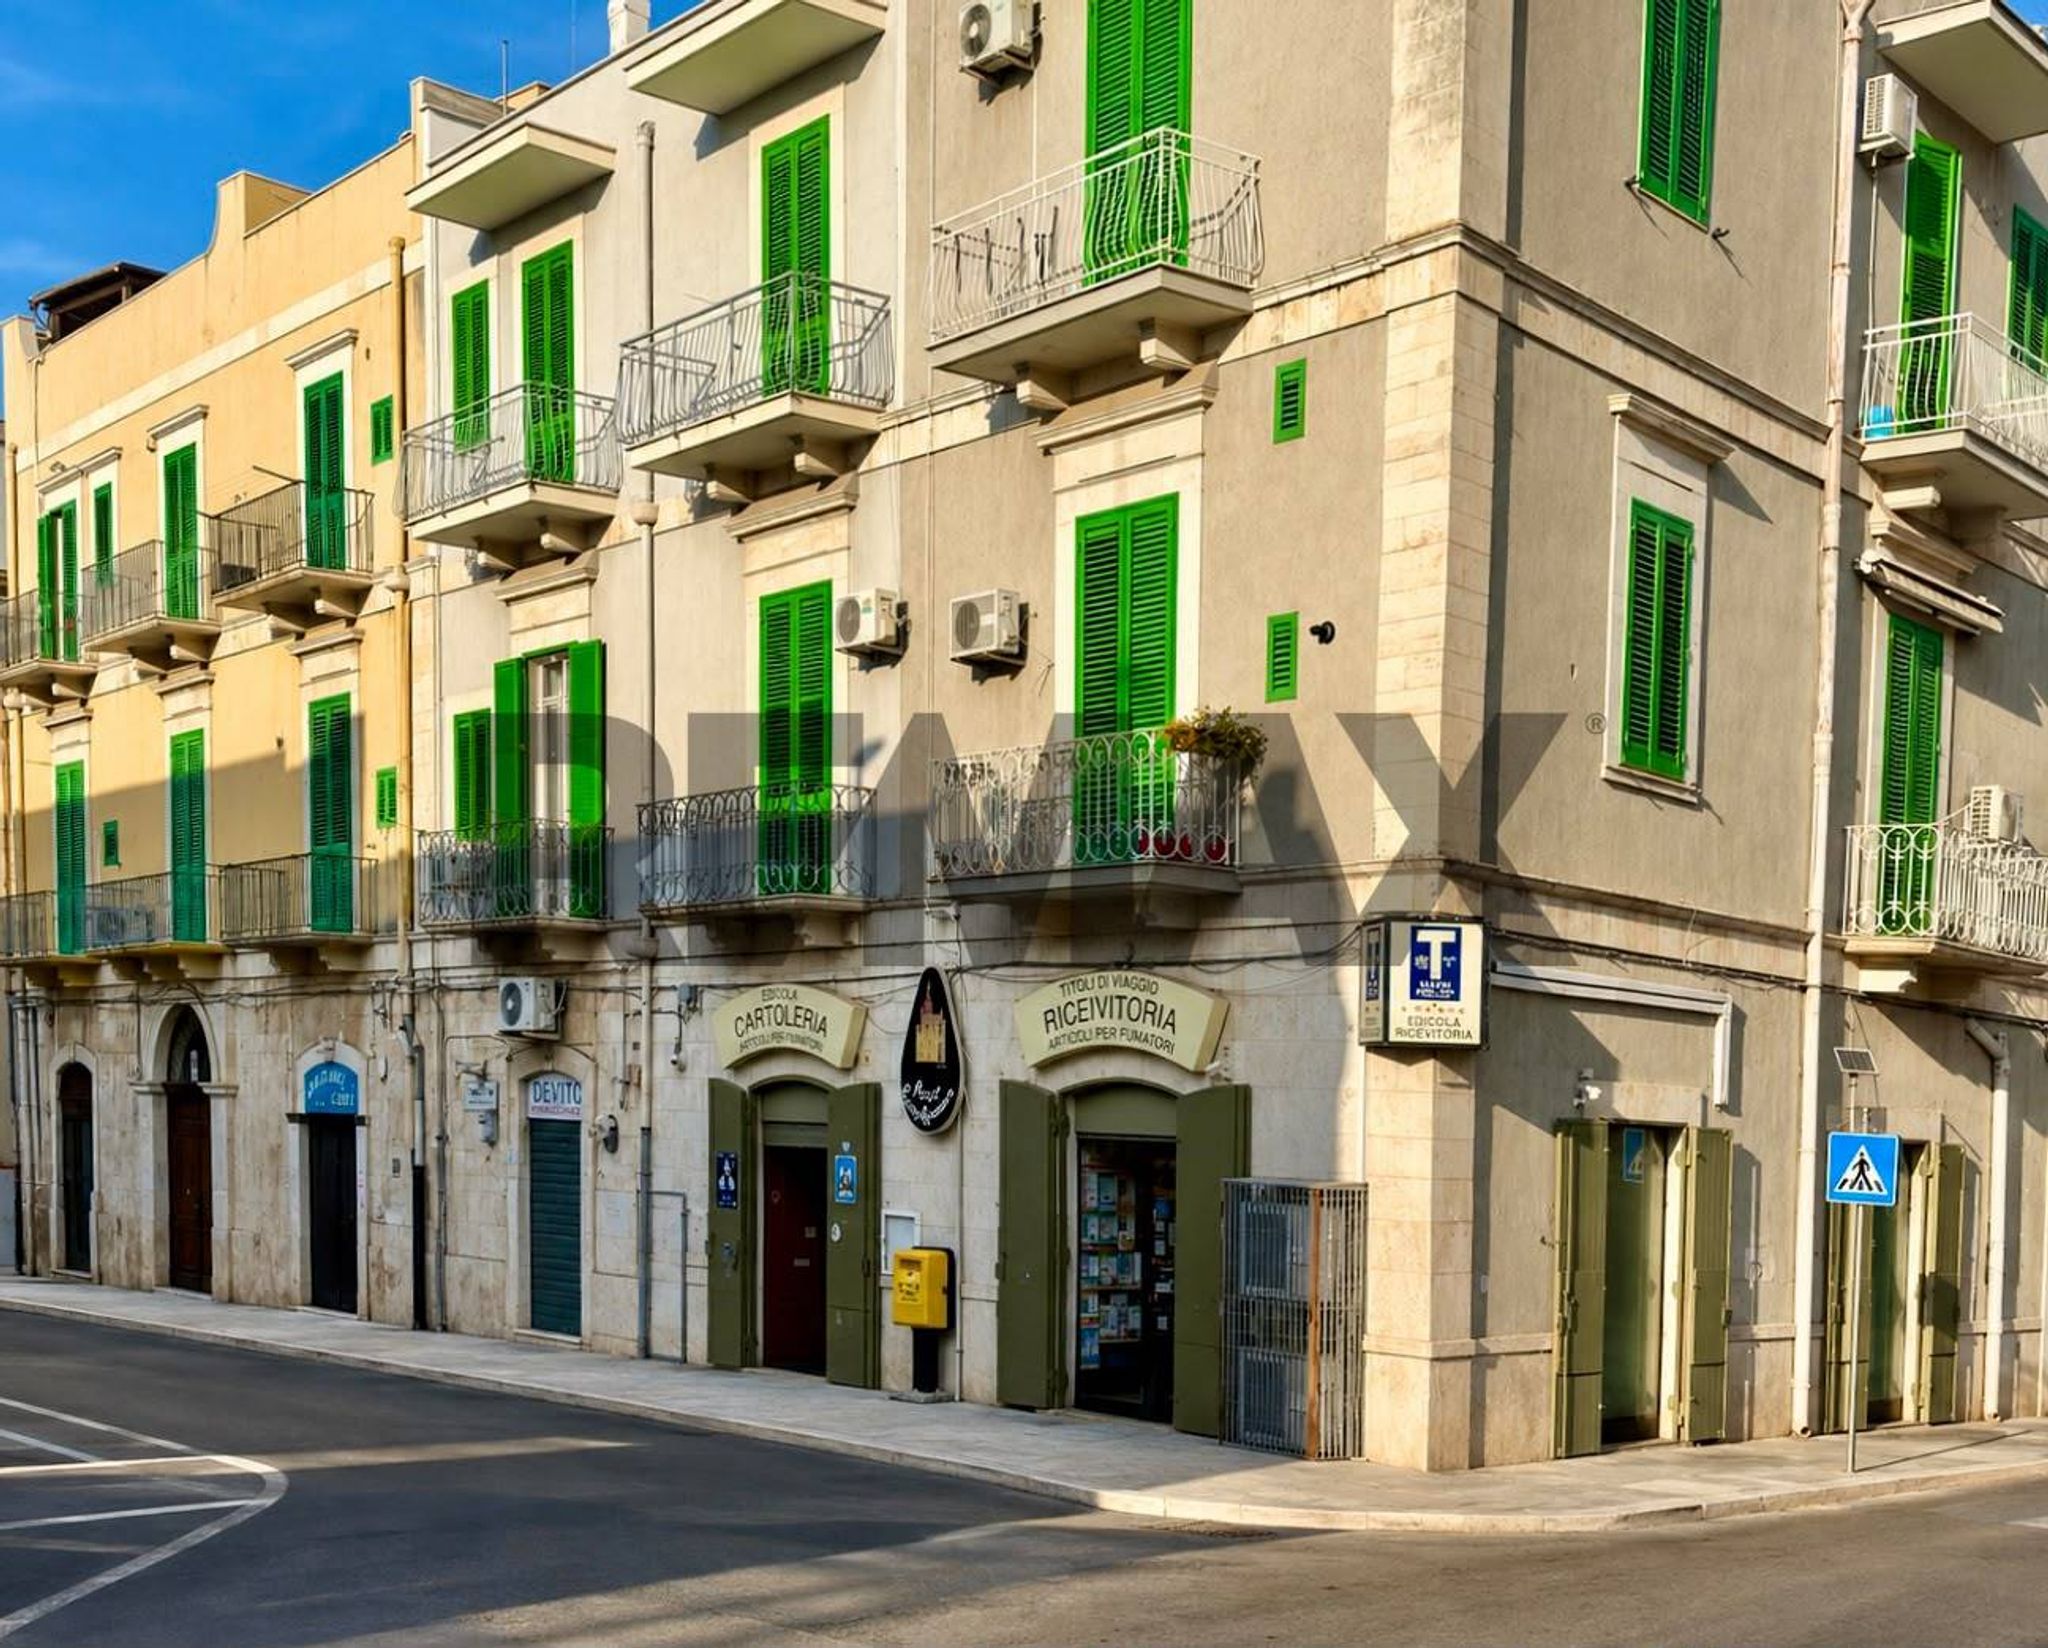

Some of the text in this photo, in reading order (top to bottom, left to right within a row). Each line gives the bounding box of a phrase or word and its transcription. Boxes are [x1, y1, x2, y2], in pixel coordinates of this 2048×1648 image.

[1416, 929, 1456, 980] T
[1111, 974, 1160, 996] VIAGGIO
[734, 1003, 828, 1038] CARTOLERIA
[1394, 1026, 1473, 1040] RICEVITORIA
[1407, 1015, 1462, 1028] EDICOLA
[1095, 1026, 1118, 1041] PER
[1119, 1027, 1176, 1056] FUMATORI
